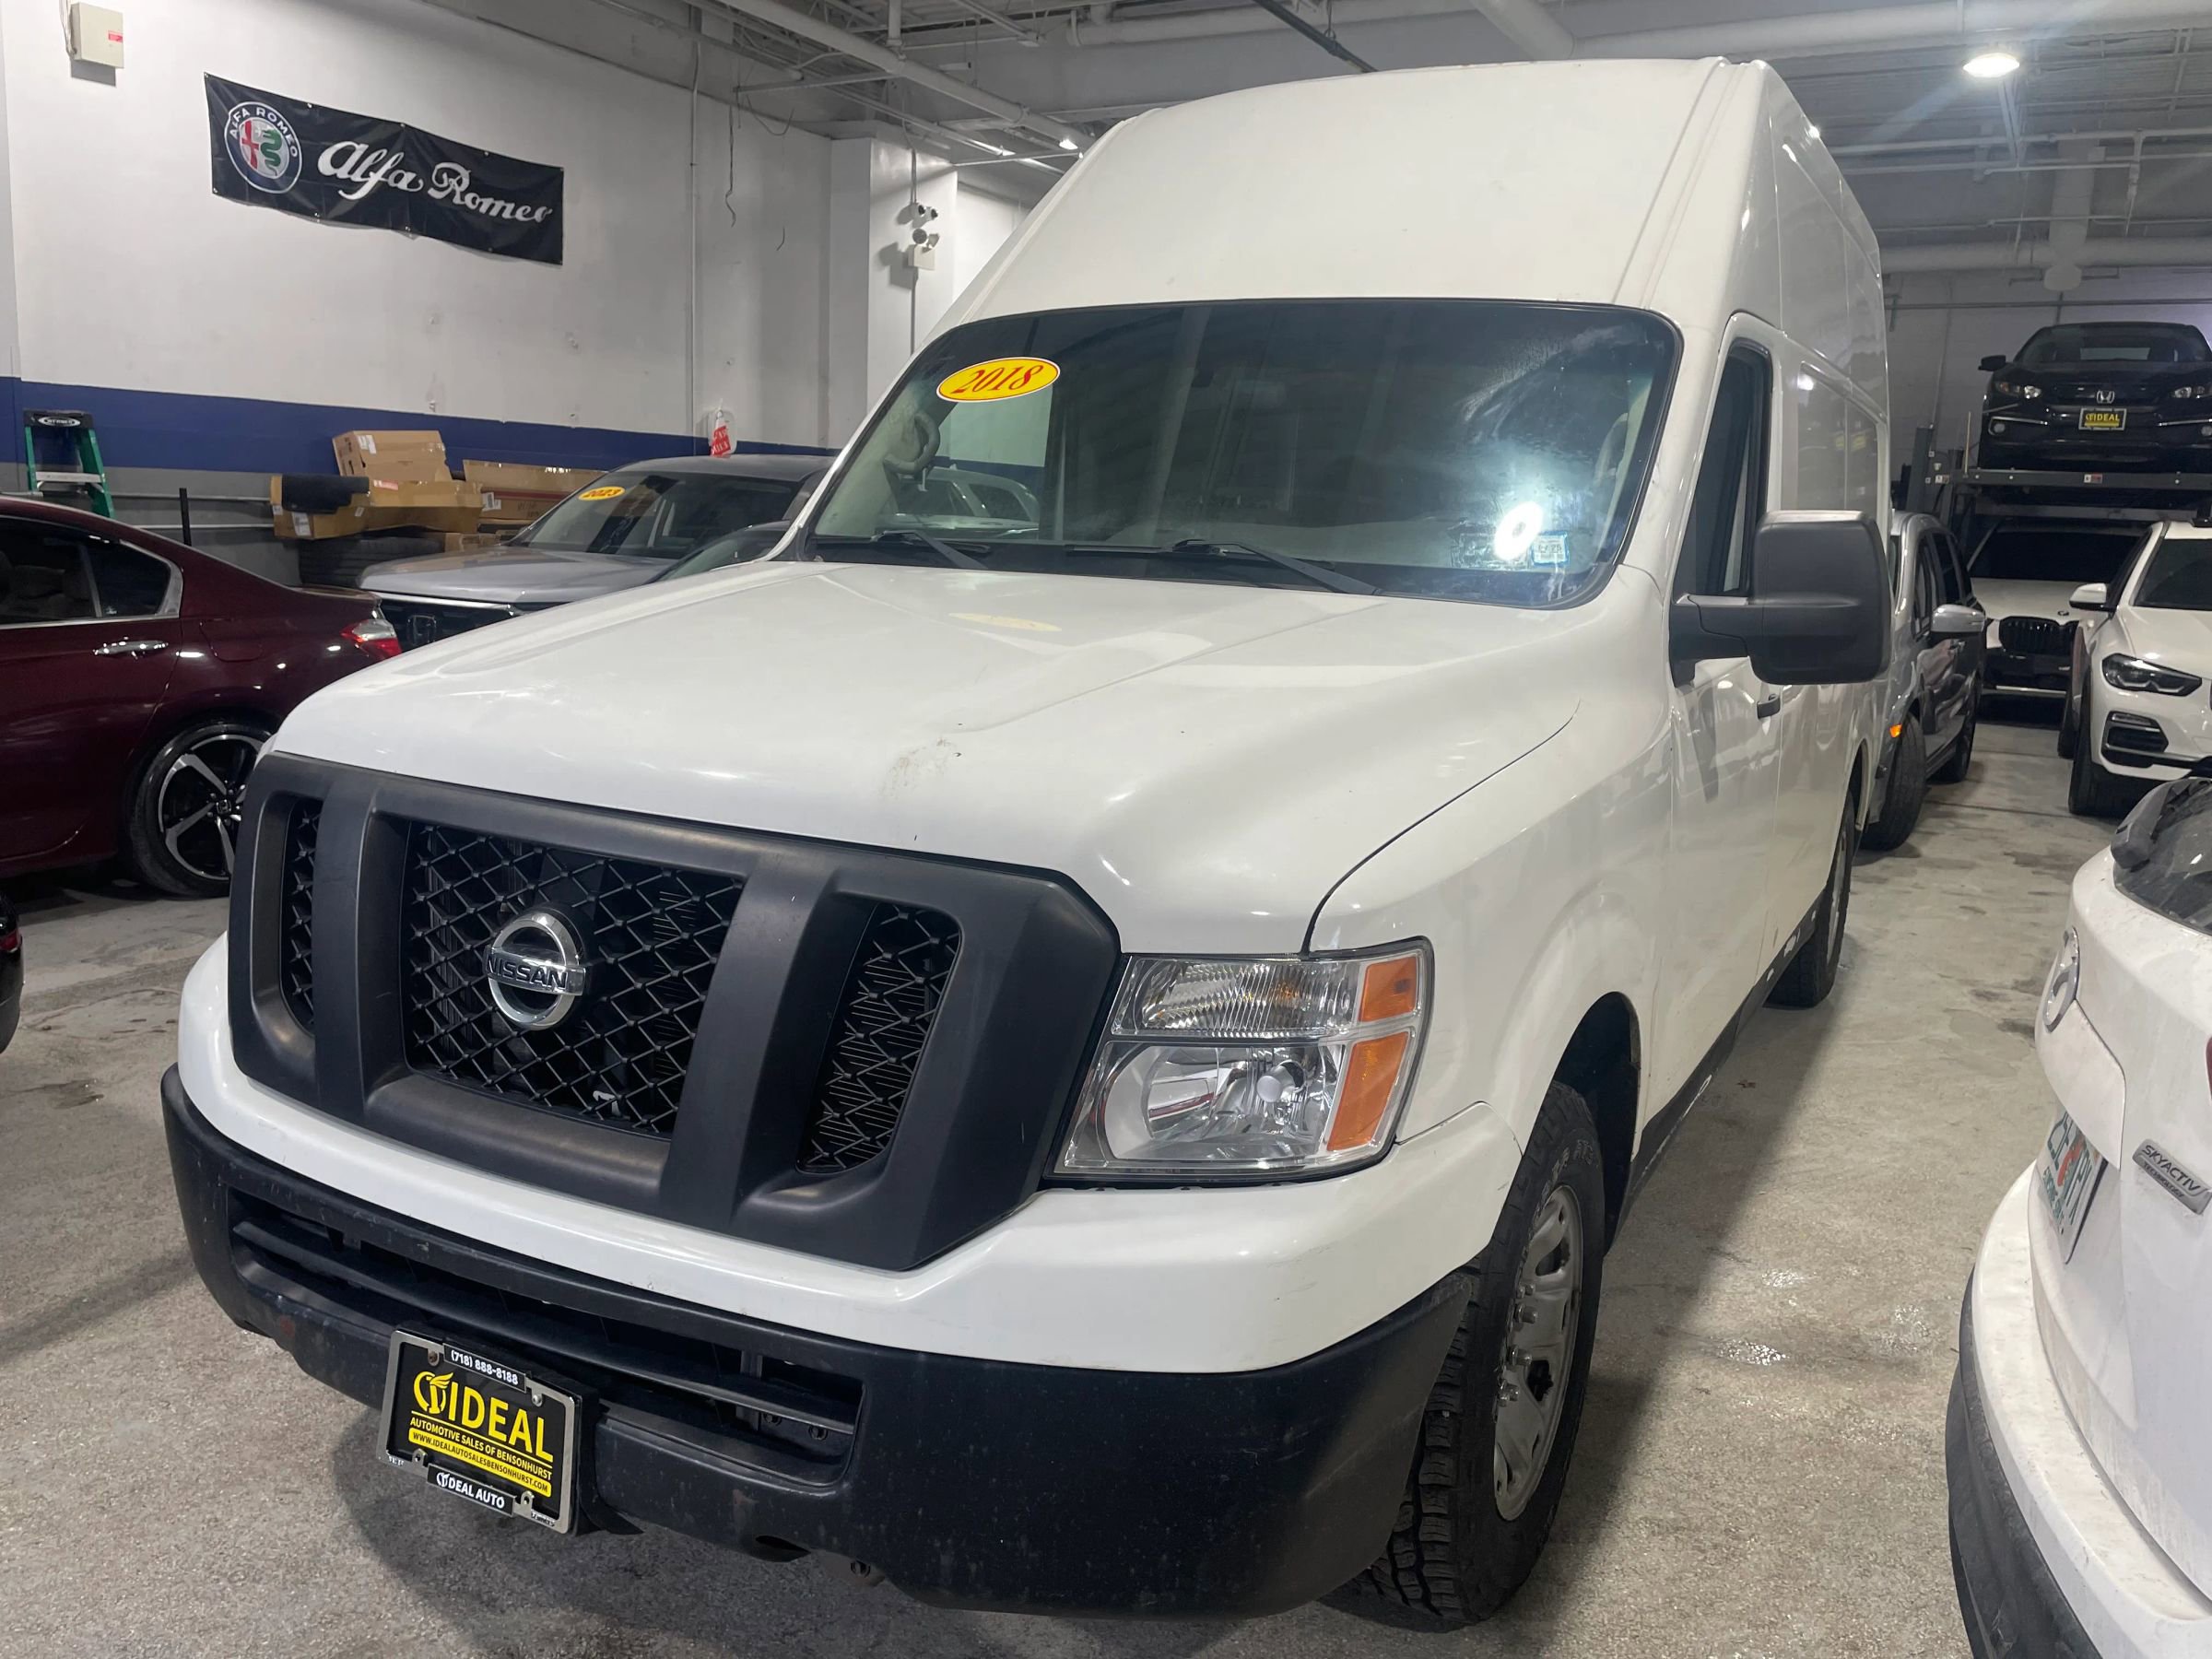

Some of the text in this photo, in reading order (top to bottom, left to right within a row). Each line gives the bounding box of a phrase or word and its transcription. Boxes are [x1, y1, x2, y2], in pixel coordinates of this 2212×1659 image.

[229, 107, 298, 157] ALFA ROMEO
[317, 141, 553, 223] Alfa Romeo
[950, 365, 1044, 394] 2018
[2093, 413, 2120, 422] IDEAL
[487, 953, 568, 991] NISSAN
[2142, 1145, 2201, 1191] SKYACTIV
[451, 1349, 518, 1385] (718) 888-8188
[448, 1381, 554, 1463] IDEAL
[410, 1417, 552, 1480] AUTOMOTIVE SALES OF BENSONHURST
[413, 1431, 548, 1493] WWW.IDEALAUTOSALESBENSONHURST.COM
[476, 1488, 505, 1509] AUTO
